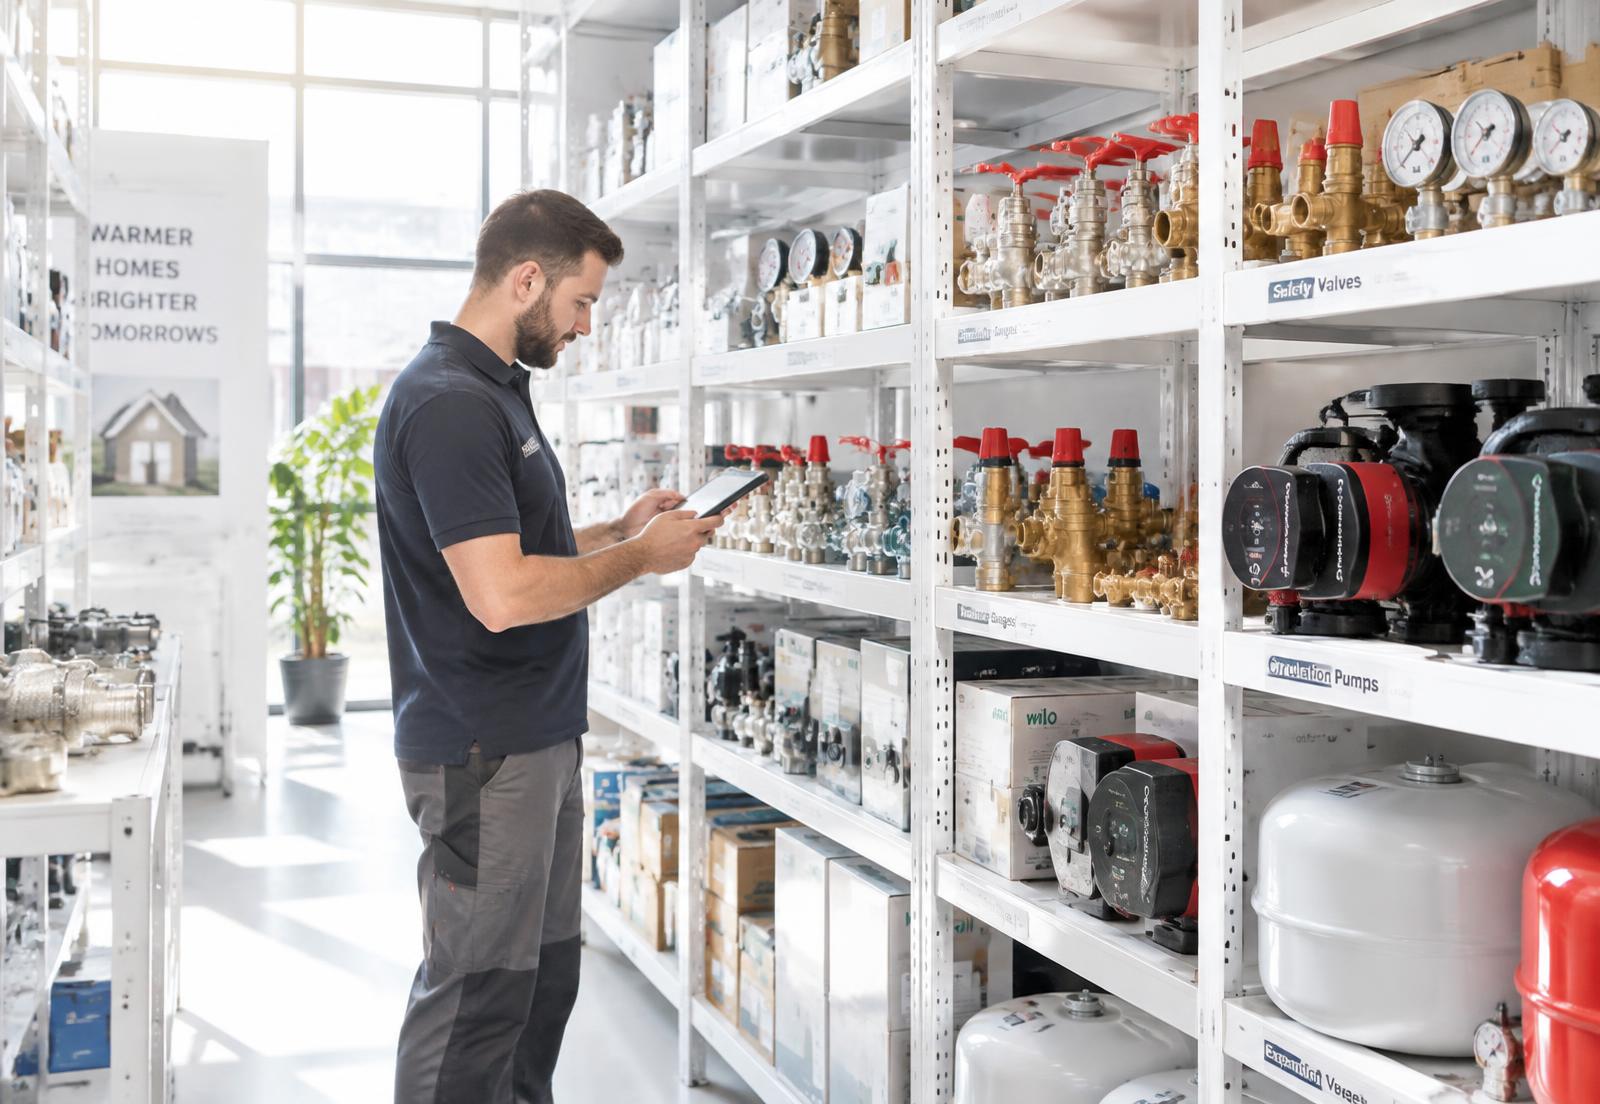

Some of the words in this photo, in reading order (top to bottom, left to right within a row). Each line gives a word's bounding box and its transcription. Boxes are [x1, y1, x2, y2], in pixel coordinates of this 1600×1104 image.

[91, 223, 194, 247] WARMER
[95, 257, 181, 280] HOMES
[1317, 275, 1362, 293] Valves
[90, 290, 198, 312] RIGHTER
[90, 322, 219, 345] OMORROWS
[1334, 668, 1380, 694] Pumps
[1026, 707, 1057, 726] wilo
